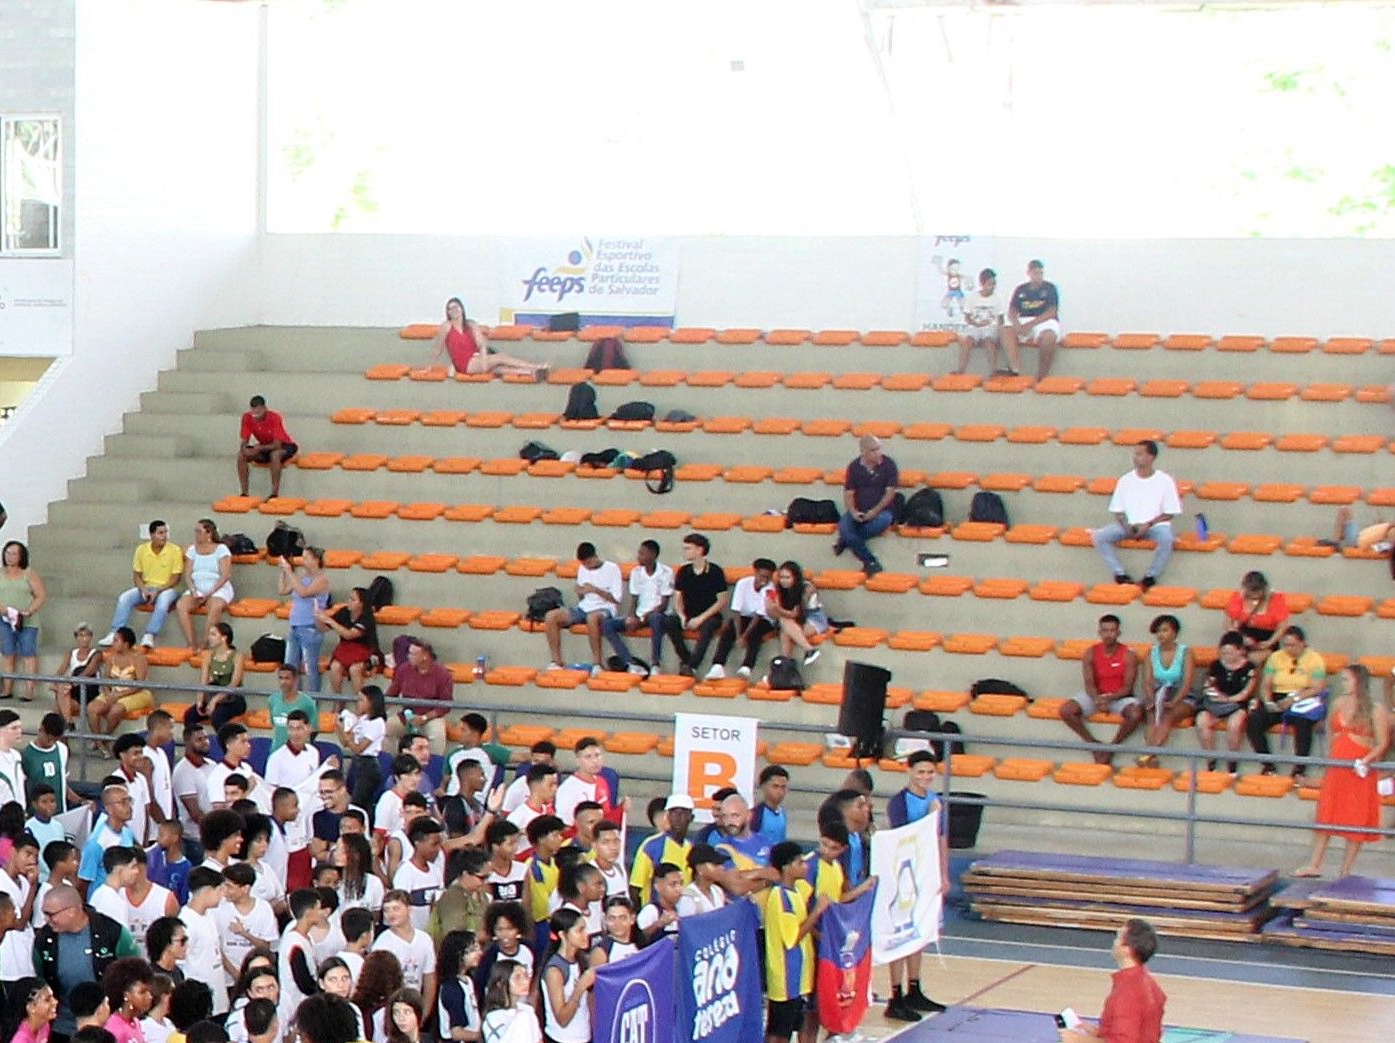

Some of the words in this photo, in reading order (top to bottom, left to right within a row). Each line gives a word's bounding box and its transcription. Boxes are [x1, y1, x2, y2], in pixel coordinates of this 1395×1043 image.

[595, 251, 652, 263] Esportivo
[593, 262, 615, 273] das
[618, 262, 660, 273] Escolas
[522, 267, 587, 302] feeps
[590, 273, 661, 285] Particulares
[588, 284, 605, 295] de
[608, 284, 660, 296] Salvador
[691, 726, 741, 741] SETOR
[688, 750, 737, 810] B
